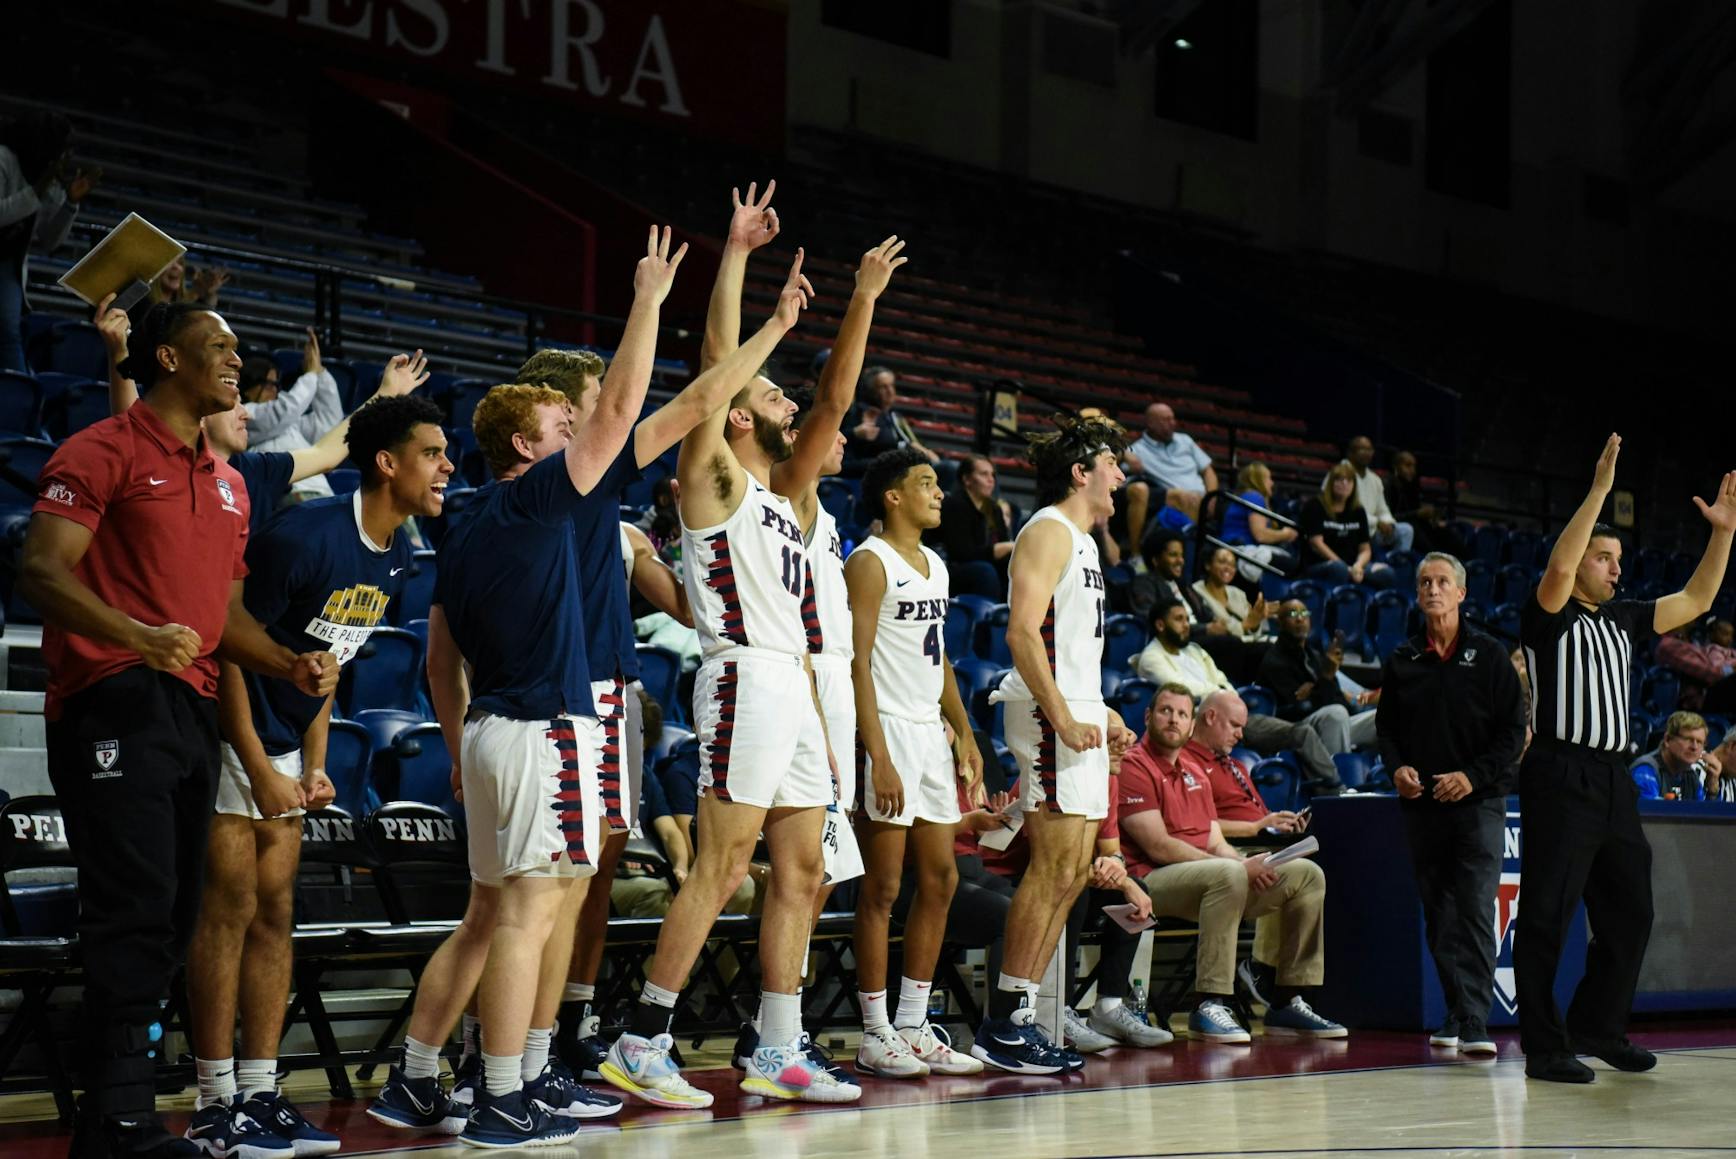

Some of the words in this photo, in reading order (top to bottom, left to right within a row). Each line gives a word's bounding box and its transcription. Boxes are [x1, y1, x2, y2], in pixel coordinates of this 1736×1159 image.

[781, 544, 802, 598] 11
[313, 621, 338, 639] THE
[923, 624, 941, 666] 4
[378, 816, 457, 842] PENN
